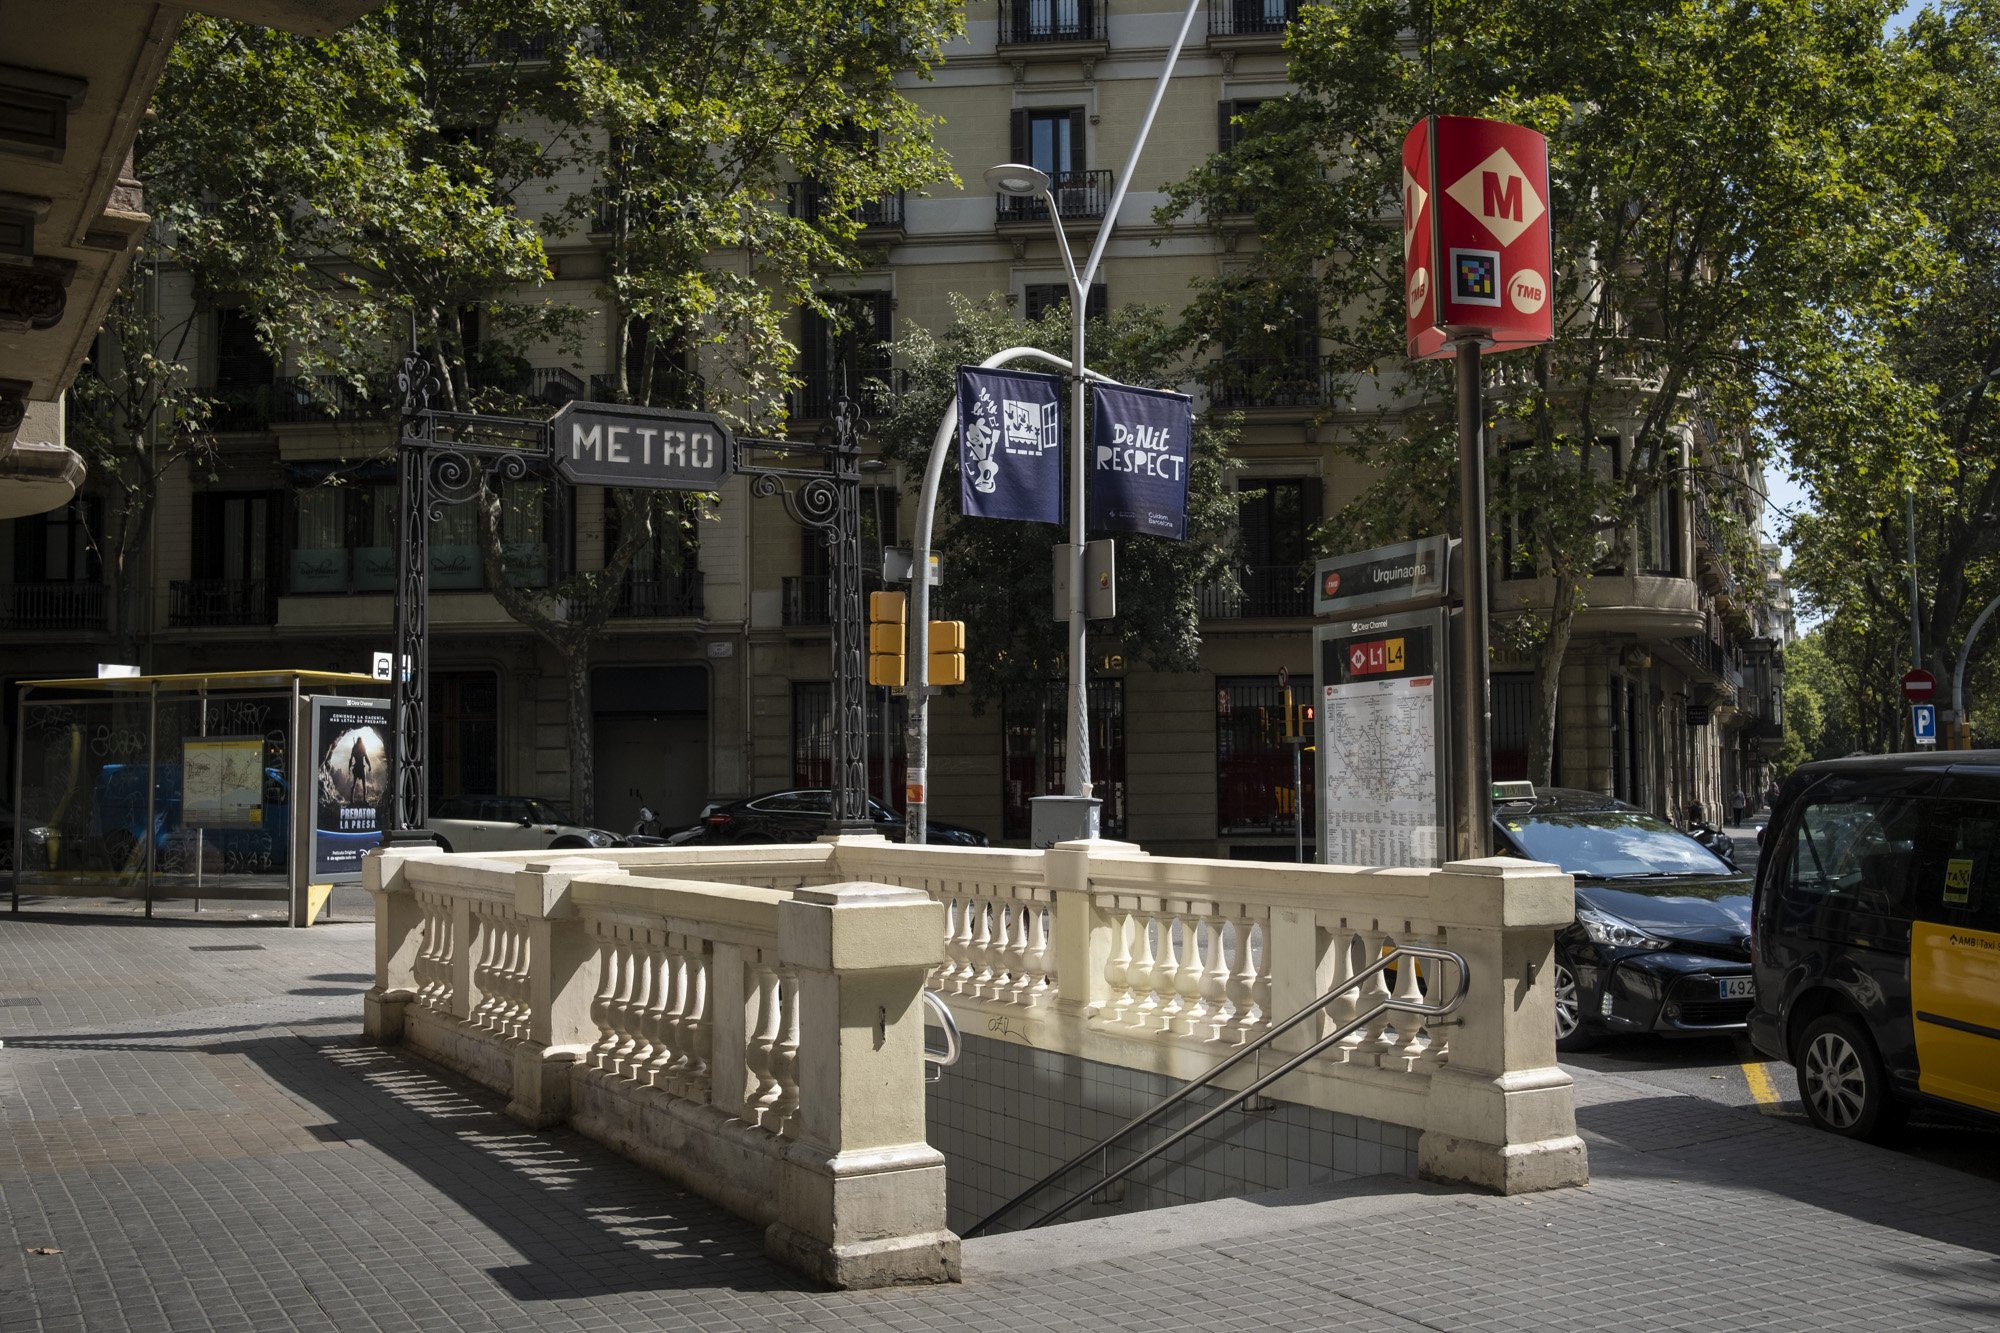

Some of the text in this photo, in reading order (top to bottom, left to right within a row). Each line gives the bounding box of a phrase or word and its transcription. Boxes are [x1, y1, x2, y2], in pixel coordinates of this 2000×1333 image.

[1482, 170, 1524, 223] M
[1410, 282, 1426, 302] TMB
[1516, 283, 1542, 301] TMB
[572, 422, 715, 469] METRO
[1112, 423, 1170, 451] De Nit
[1096, 445, 1184, 481] RESPECT
[1373, 564, 1426, 584] Urquinaona
[1357, 619, 1388, 631] Clear Channel
[1369, 647, 1383, 666] L1
[1387, 645, 1403, 664] L4
[1918, 708, 1930, 734] P
[1504, 785, 1522, 796] TAXI
[341, 808, 376, 819] PREDATOR
[340, 820, 376, 829] LA PRESA
[1980, 939, 1995, 950] Taxi
